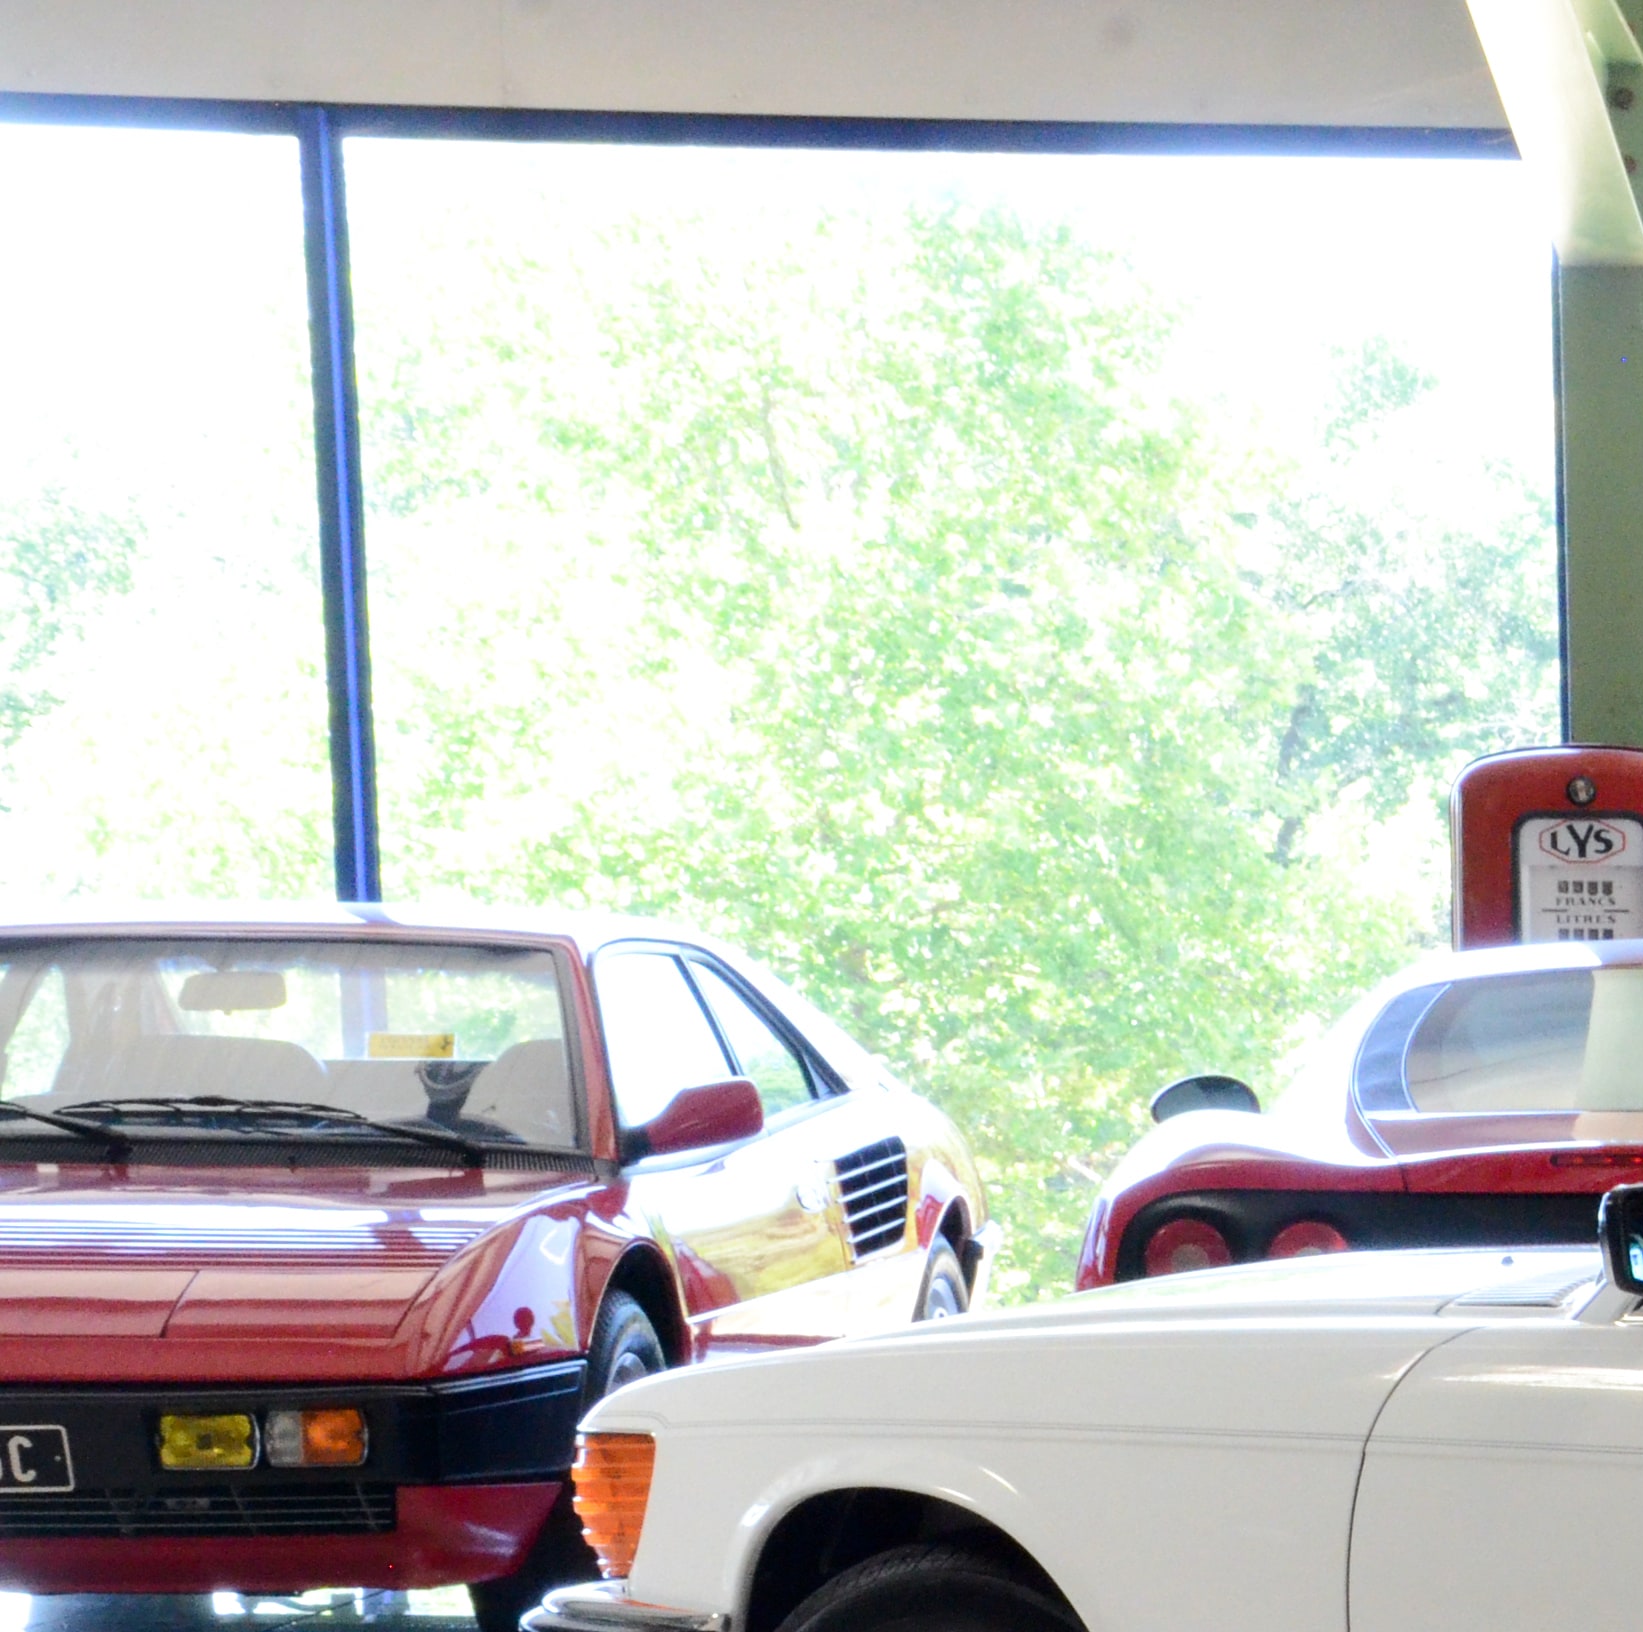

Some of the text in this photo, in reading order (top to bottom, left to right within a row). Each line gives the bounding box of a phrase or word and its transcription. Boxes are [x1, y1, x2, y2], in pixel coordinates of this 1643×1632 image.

[1550, 823, 1613, 858] LYS
[1556, 897, 1615, 906] FRANCS
[1556, 915, 1615, 923] LITRES
[0, 1435, 37, 1482] C
